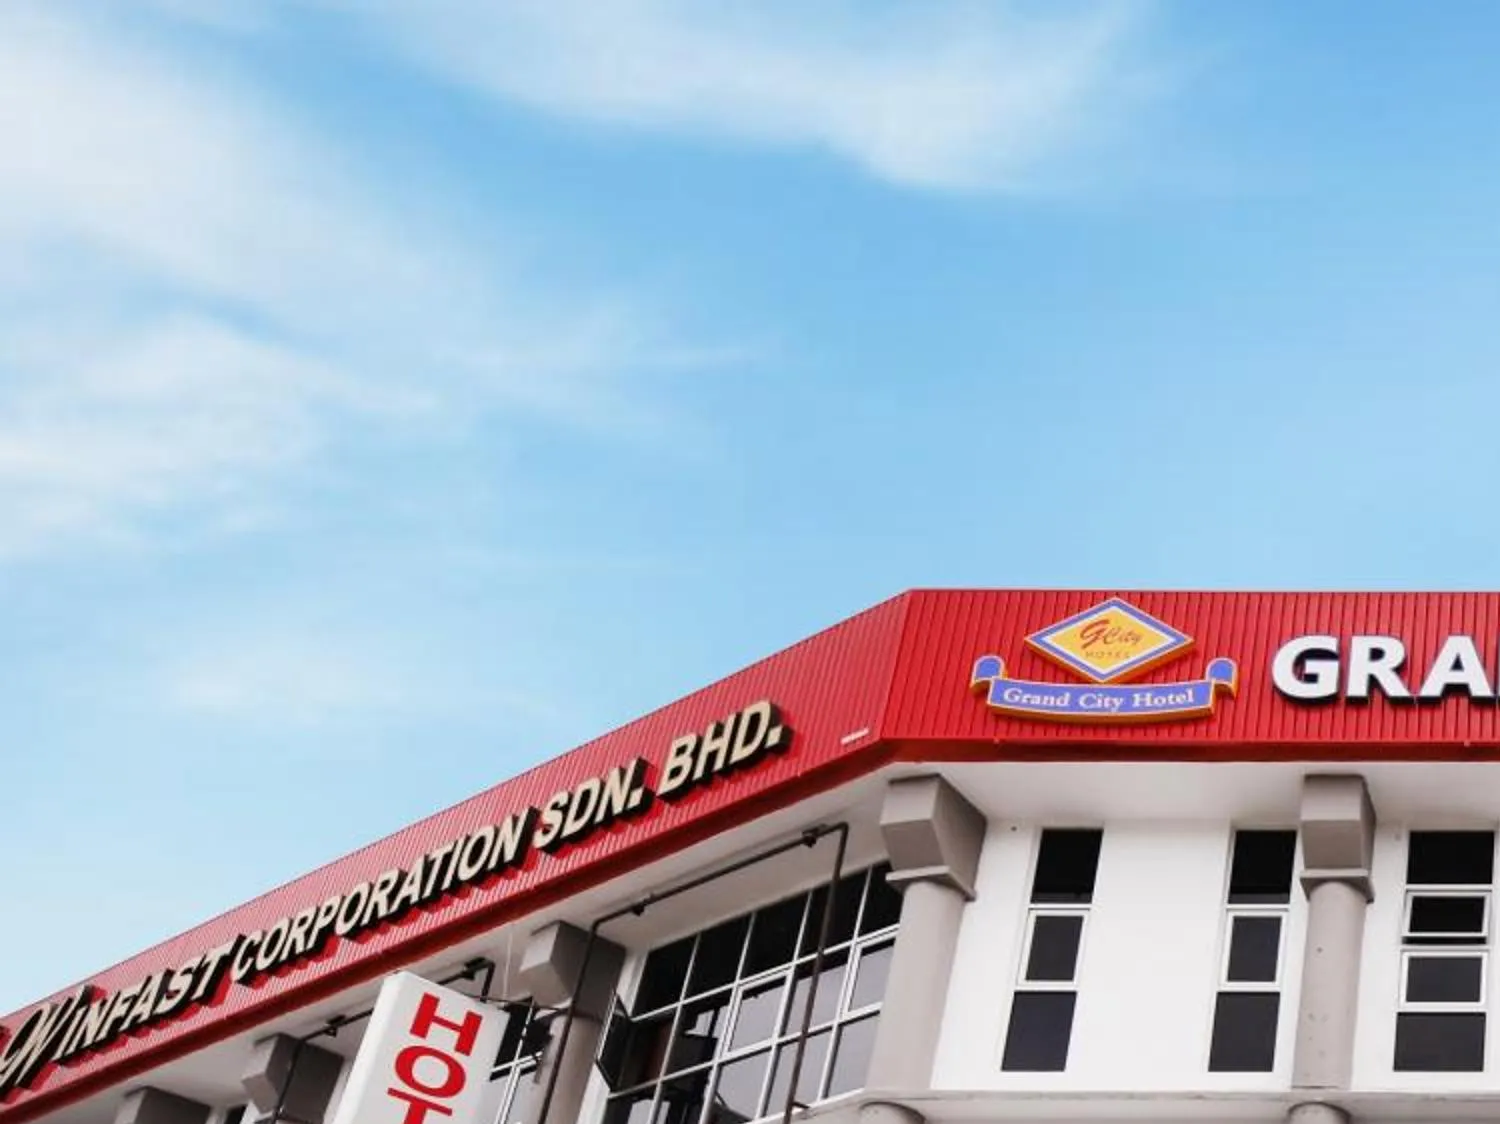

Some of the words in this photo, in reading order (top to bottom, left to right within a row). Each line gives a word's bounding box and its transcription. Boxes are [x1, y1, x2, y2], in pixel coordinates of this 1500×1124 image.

[1003, 687, 1070, 708] Grand
[1079, 692, 1124, 711] City
[1132, 688, 1194, 708] Hotel
[231, 812, 527, 983] CORPORATION
[533, 759, 645, 850] SDN.
[658, 700, 783, 798] BHD.
